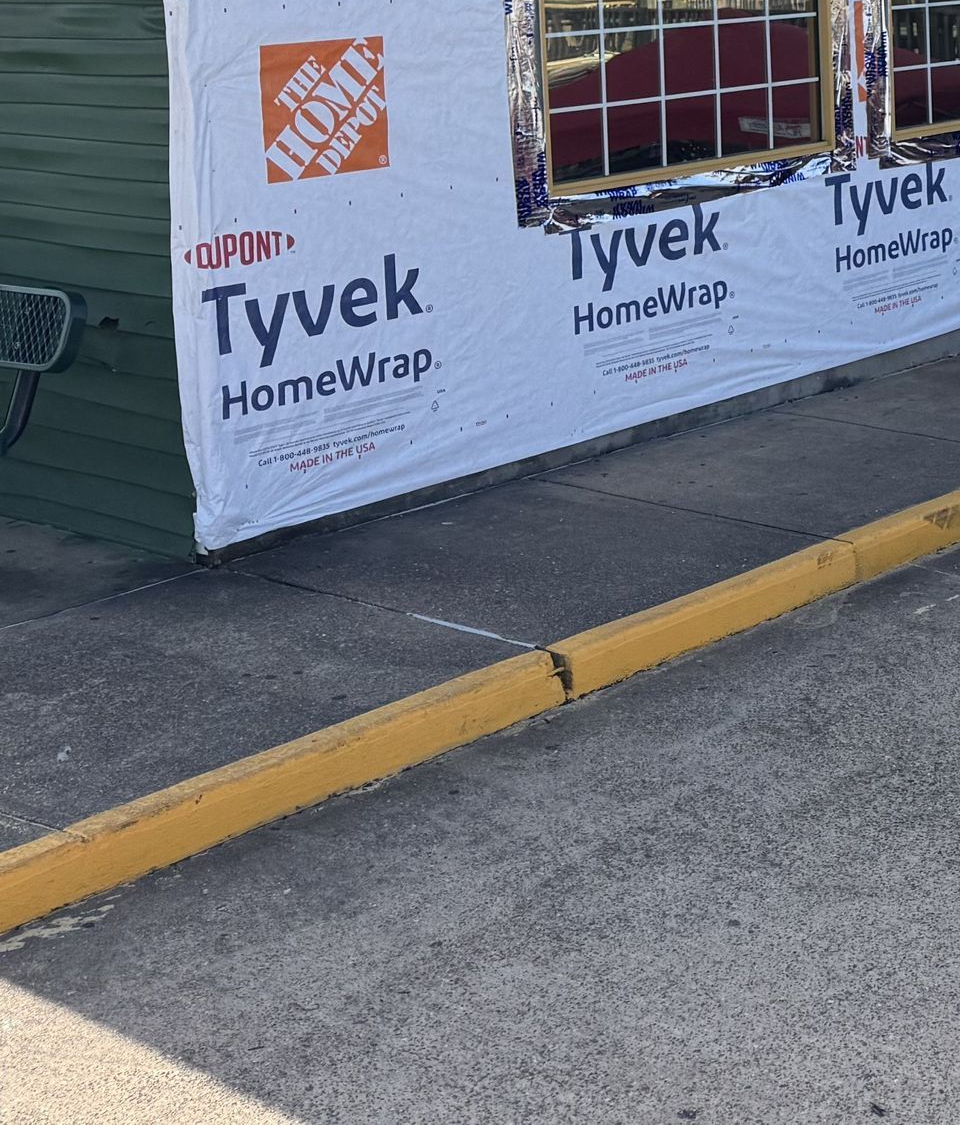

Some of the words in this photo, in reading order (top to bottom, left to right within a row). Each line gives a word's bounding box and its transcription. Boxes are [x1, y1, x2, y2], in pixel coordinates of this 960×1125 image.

[264, 37, 386, 181] HOME
[273, 55, 326, 112] THE
[315, 86, 387, 176] DEPOT
[824, 162, 949, 236] Tyvek
[196, 230, 283, 270] DUPONT
[560, 204, 723, 292] Tyvek
[835, 226, 954, 273] HomeWrap
[202, 253, 425, 369] Tyvek
[573, 278, 729, 336] HomeWrap
[874, 304, 891, 314] MADE
[892, 302, 899, 310] IN
[899, 298, 910, 307] THE
[911, 295, 922, 304] USA
[221, 348, 433, 420] HomeWrap
[602, 367, 613, 376] Call
[624, 370, 647, 382] MADE
[648, 367, 657, 376] IN
[658, 362, 673, 374] THE
[673, 358, 688, 368] USA
[258, 454, 273, 467] Call
[273, 442, 330, 463] 1-800-448-9835
[332, 423, 406, 448] tyvek.com/homewrap
[289, 456, 320, 472] MADE
[322, 452, 334, 464] IN
[336, 448, 354, 460] THE
[355, 442, 376, 455] USA
